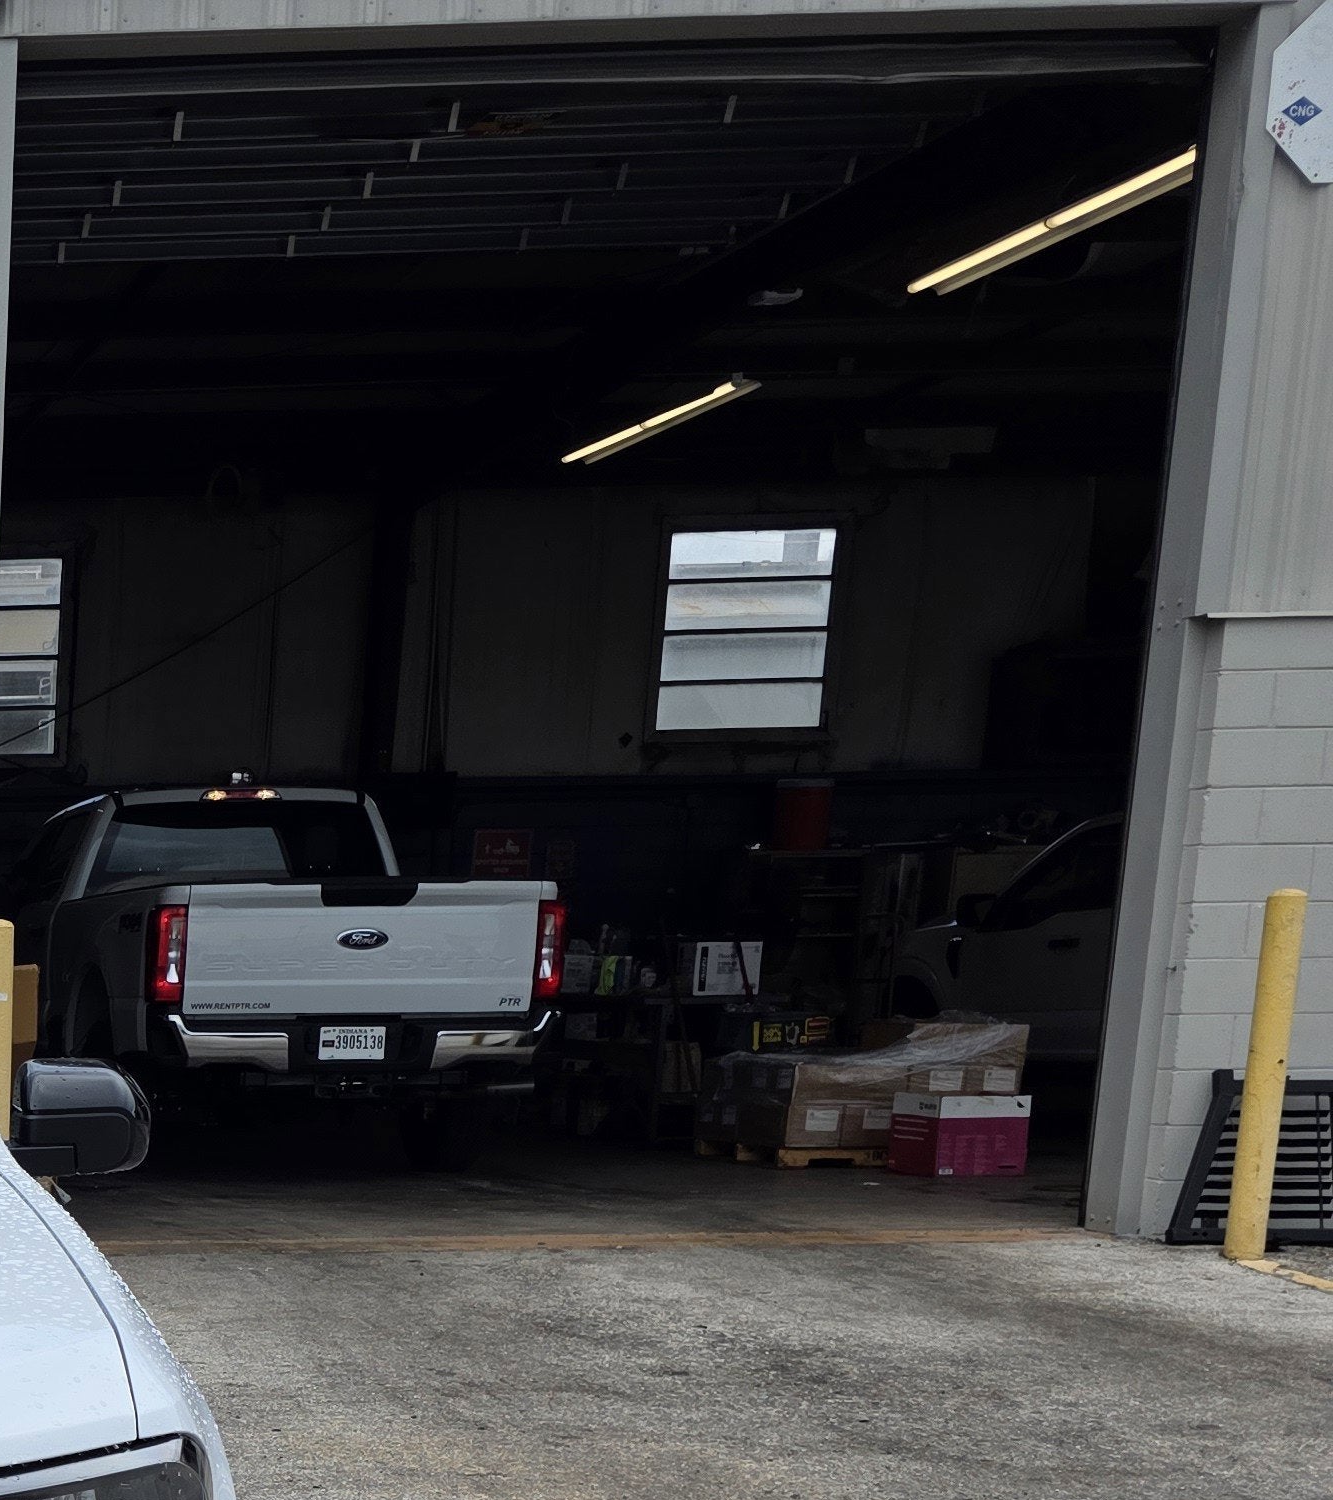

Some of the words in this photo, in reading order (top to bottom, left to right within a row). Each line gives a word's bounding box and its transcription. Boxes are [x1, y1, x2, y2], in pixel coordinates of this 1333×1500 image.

[1288, 104, 1315, 117] CNG
[205, 958, 374, 972] SUPER
[190, 1002, 271, 1010] WWW.RENTPTR.COM
[498, 997, 522, 1007] PTR
[335, 1034, 384, 1050] 3905138
